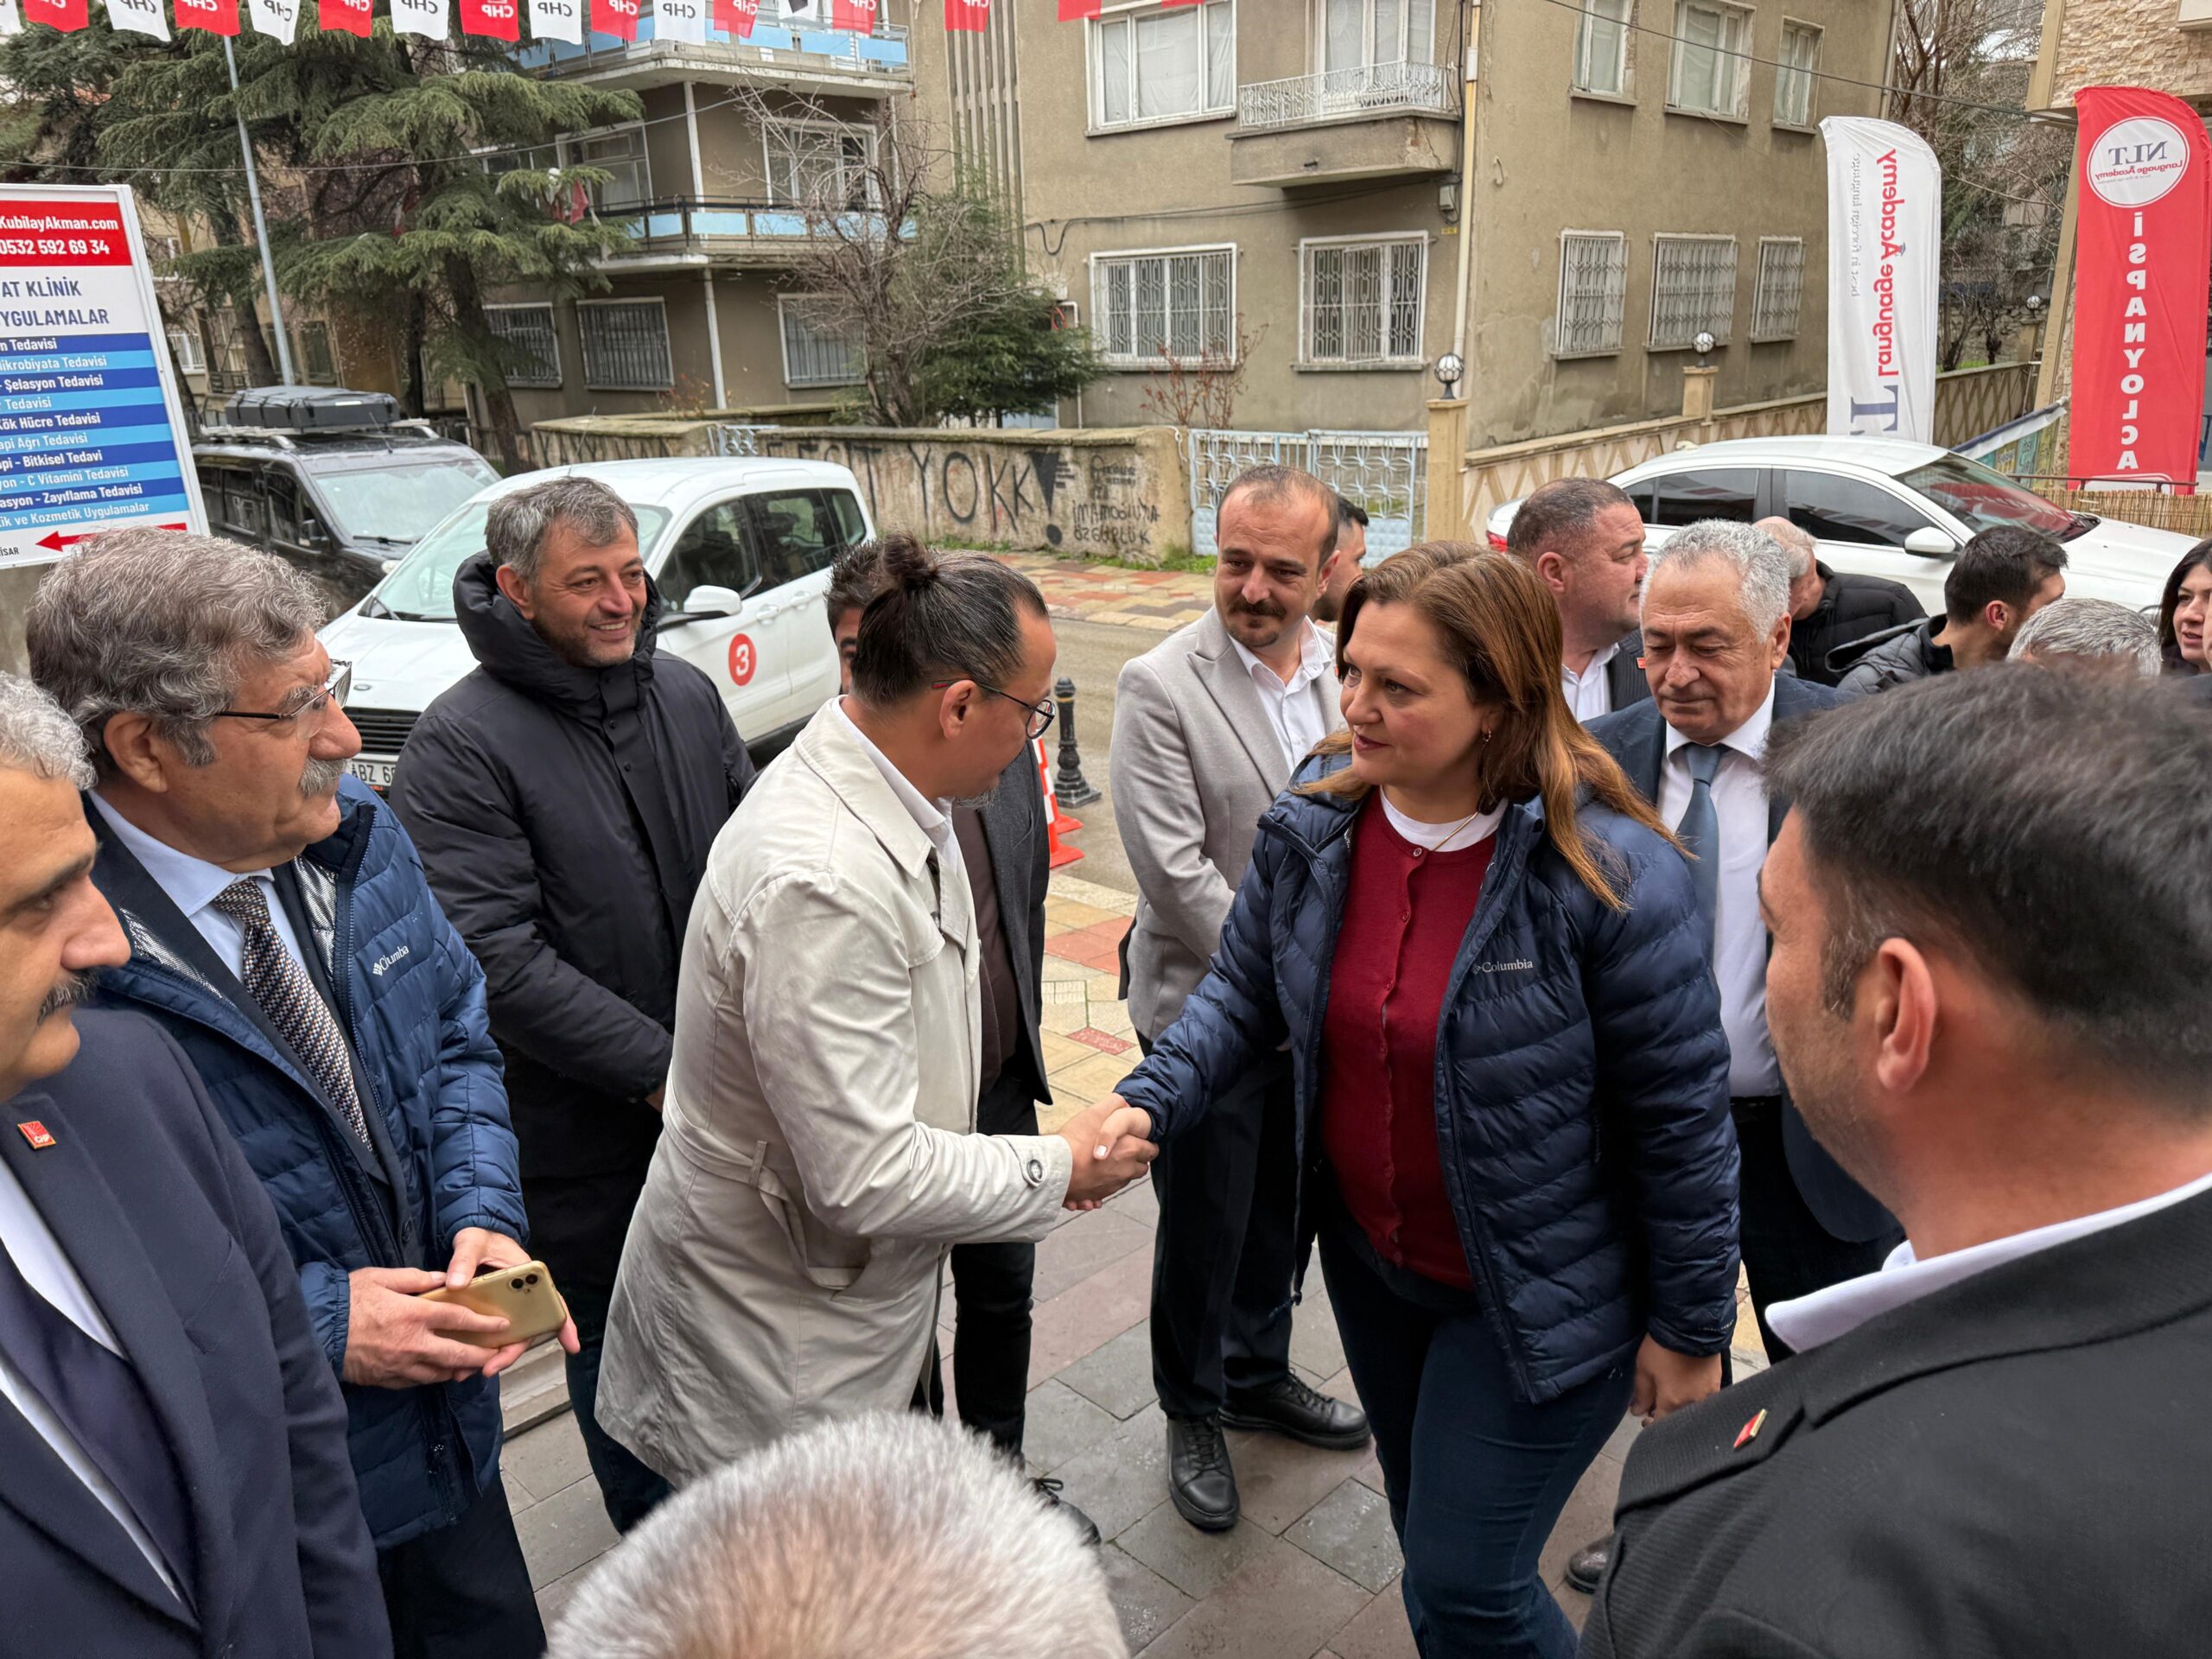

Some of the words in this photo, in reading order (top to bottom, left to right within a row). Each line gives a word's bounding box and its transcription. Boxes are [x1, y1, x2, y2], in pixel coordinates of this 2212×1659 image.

[0, 215, 119, 232] KubilayAkman.com
[0, 239, 36, 255] 0532
[37, 239, 67, 255] 592
[68, 239, 88, 255] 69
[89, 239, 111, 255] 34
[26, 276, 82, 297] KLİNİK
[10, 338, 58, 352] Tedavisi
[0, 357, 60, 372] ikrobiyata
[62, 355, 107, 368] Tedavisi
[5, 377, 56, 393] Şelasyon
[58, 374, 104, 388] Tedavisi
[5, 397, 52, 410] Tedavisi
[19, 416, 54, 429] Hücre
[54, 412, 101, 426] Tedavisi
[17, 435, 40, 450] Ağrı
[42, 433, 88, 447] Tedavisi
[22, 454, 65, 467] Bitkisel
[66, 449, 103, 464] Tedavi
[27, 475, 35, 486] C
[37, 470, 83, 485] Vitamini
[86, 466, 129, 480] Tedavisi
[98, 483, 143, 498] Tedavisi
[15, 516, 28, 525] ve
[30, 508, 82, 524] Kozmetik
[84, 502, 149, 518] Uygulamalar
[736, 644, 749, 677] 3
[1482, 958, 1534, 973] Columbia
[34, 1135, 50, 1144] CHP
